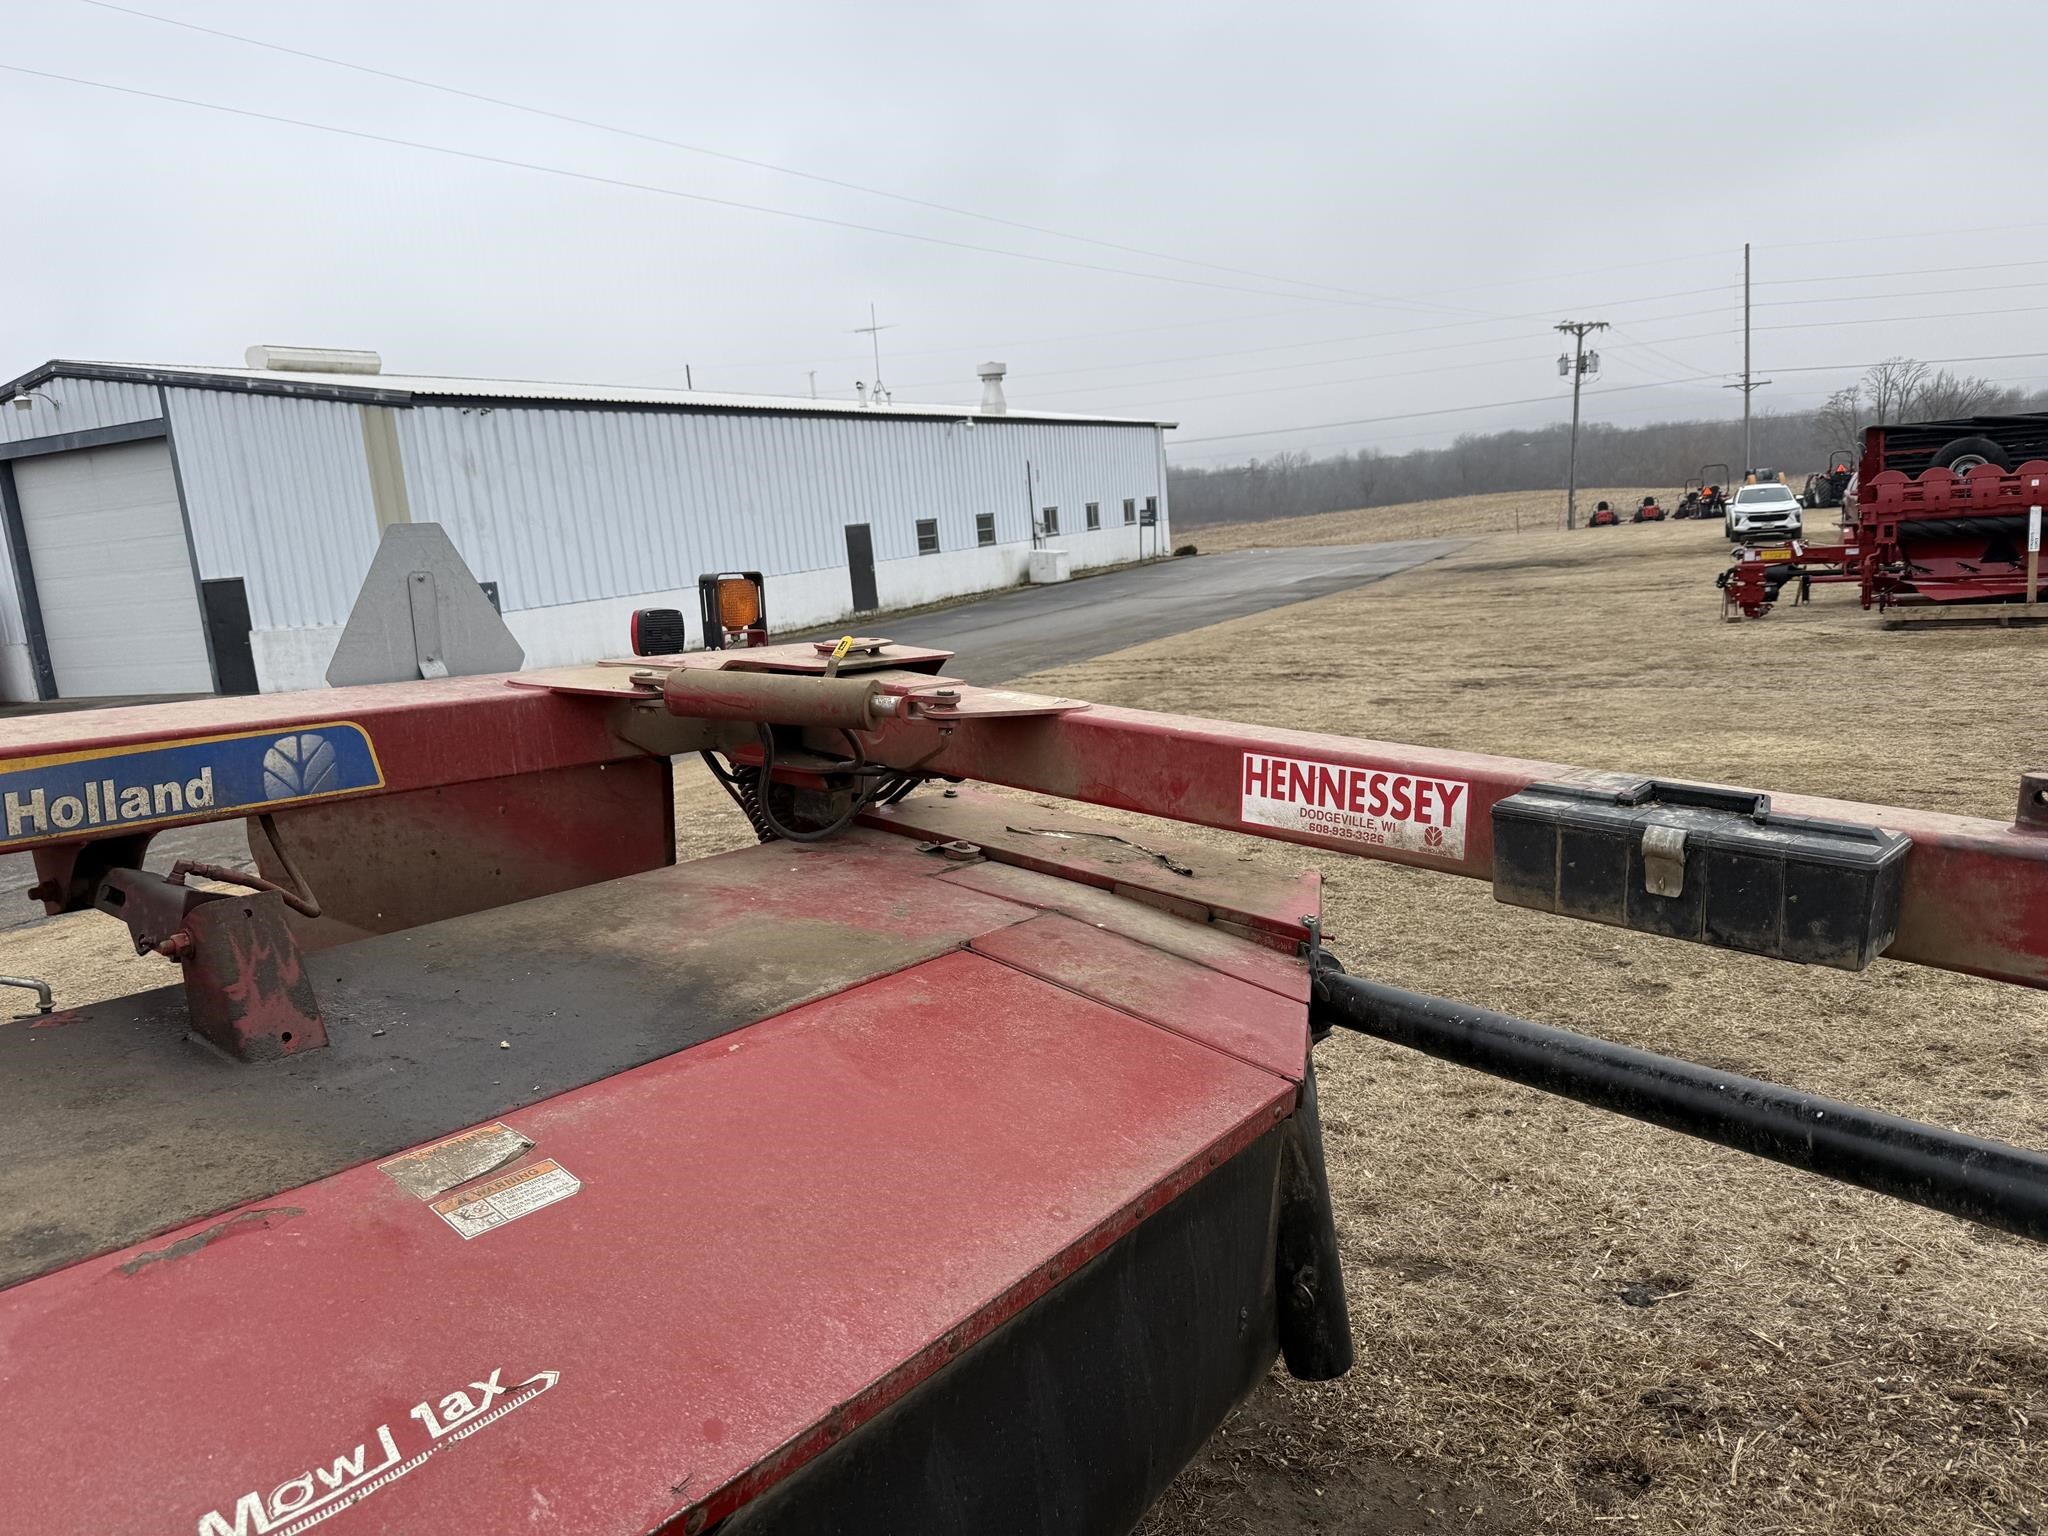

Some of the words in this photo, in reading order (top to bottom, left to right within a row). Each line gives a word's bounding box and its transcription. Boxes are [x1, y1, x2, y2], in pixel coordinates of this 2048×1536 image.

[2, 766, 215, 836] Holland
[1245, 756, 1464, 828] HENNESSEY
[1299, 807, 1378, 831] DODGEVILLE,
[1381, 820, 1396, 833] WI
[1308, 822, 1385, 844] 608-935-3326
[472, 1168, 540, 1198] WARNING
